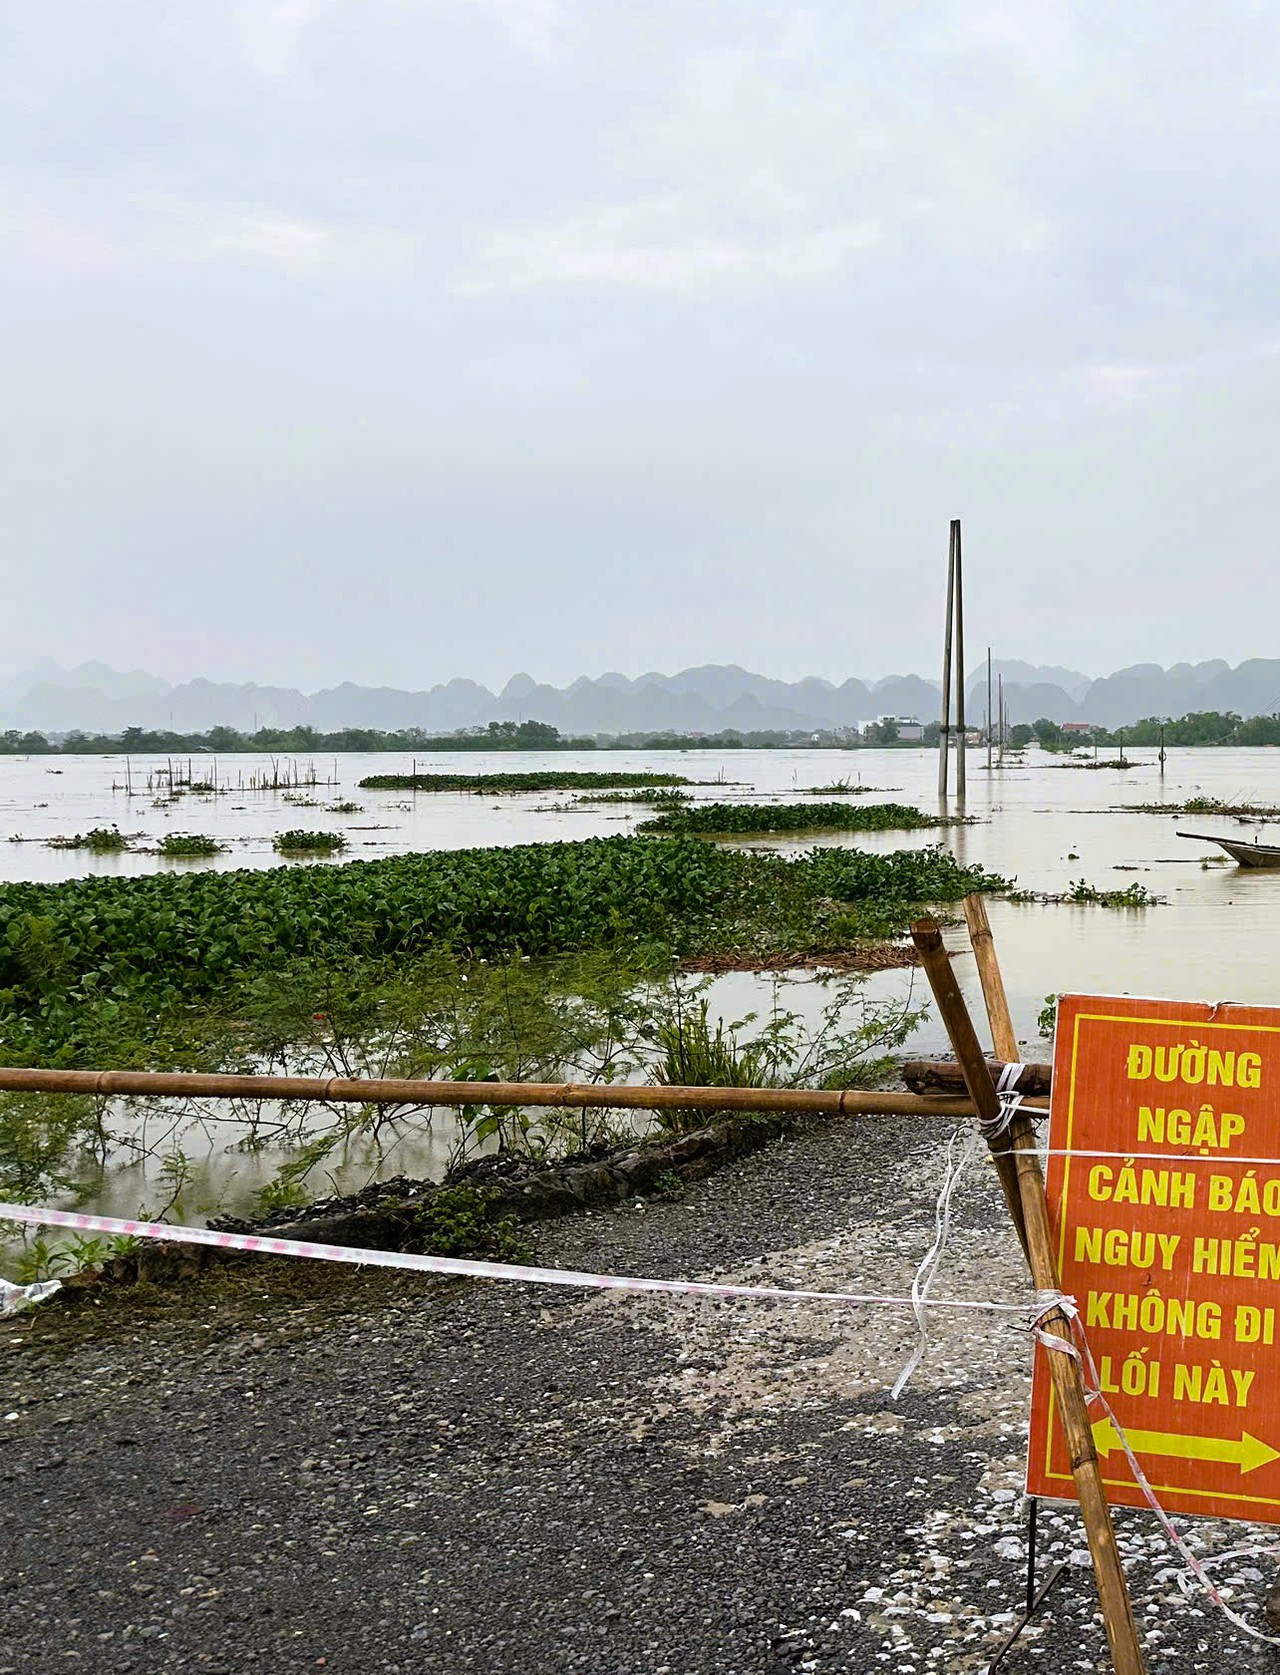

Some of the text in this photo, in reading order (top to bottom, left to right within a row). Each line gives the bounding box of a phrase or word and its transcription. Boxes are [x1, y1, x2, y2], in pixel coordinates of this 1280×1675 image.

[1126, 1038, 1262, 1089] ĐƯỜNG
[1137, 1104, 1246, 1155] NGẬP
[1088, 1156, 1196, 1209] CẢNH
[1075, 1227, 1181, 1271] NGUY
[1086, 1288, 1275, 1345] KHÔNG ĐI
[1099, 1347, 1255, 1407] LỐI NÀY
